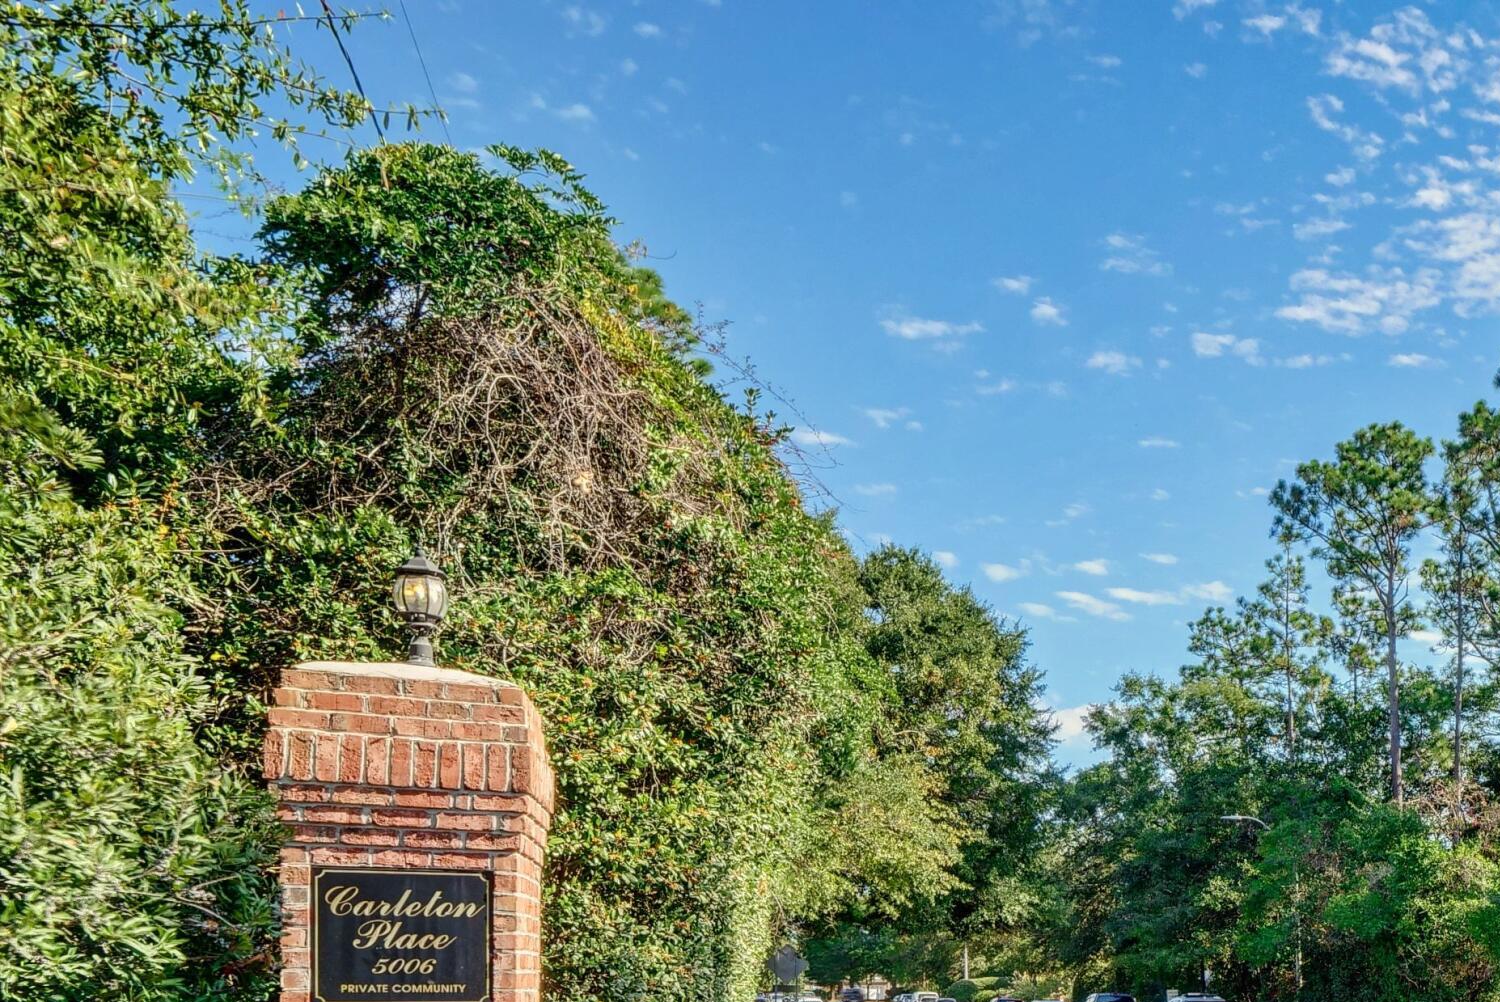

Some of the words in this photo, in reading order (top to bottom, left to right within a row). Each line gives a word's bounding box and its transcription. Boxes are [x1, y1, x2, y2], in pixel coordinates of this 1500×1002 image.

[324, 886, 487, 918] Carleton
[352, 919, 458, 950] Place
[371, 957, 438, 976] 5006
[340, 983, 389, 994] PRIVATE
[392, 983, 466, 994] COMMUNITY
